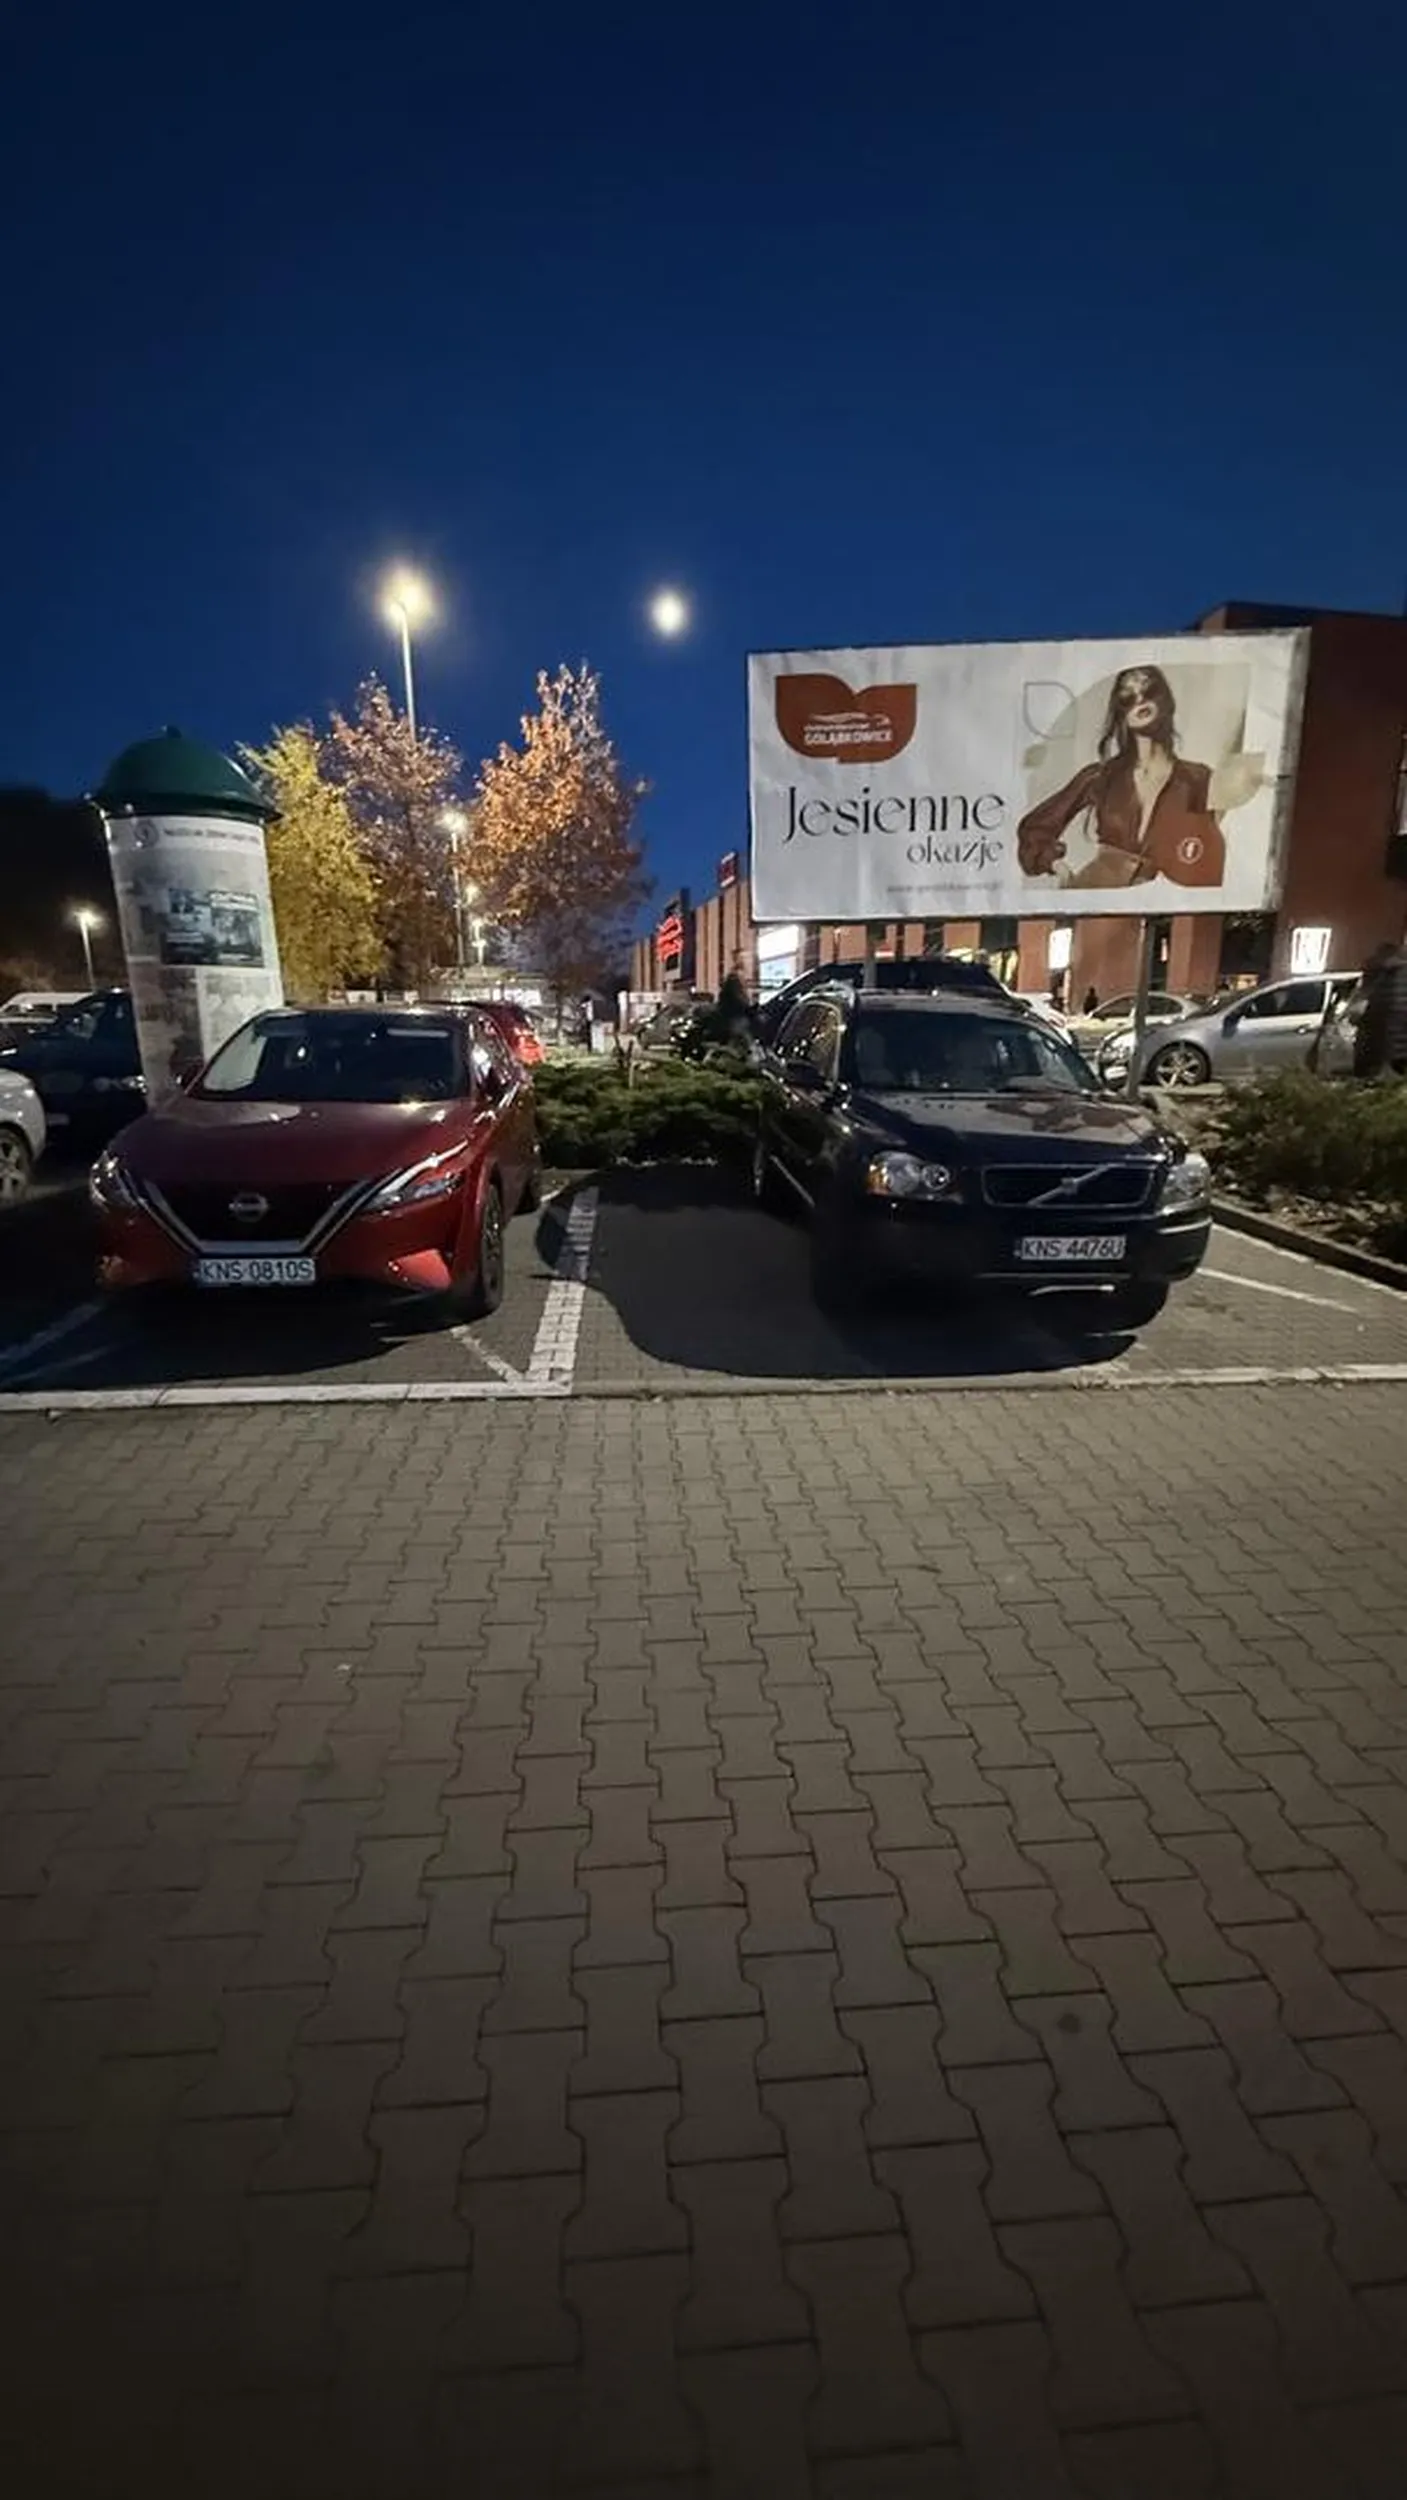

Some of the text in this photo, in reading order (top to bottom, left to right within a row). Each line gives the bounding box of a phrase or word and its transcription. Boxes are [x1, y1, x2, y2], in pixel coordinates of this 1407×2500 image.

[782, 786, 1005, 844] Jesienne
[906, 835, 1004, 871] okazje
[1023, 1239, 1062, 1258] KNS
[202, 1260, 314, 1280] KNS 0810S
